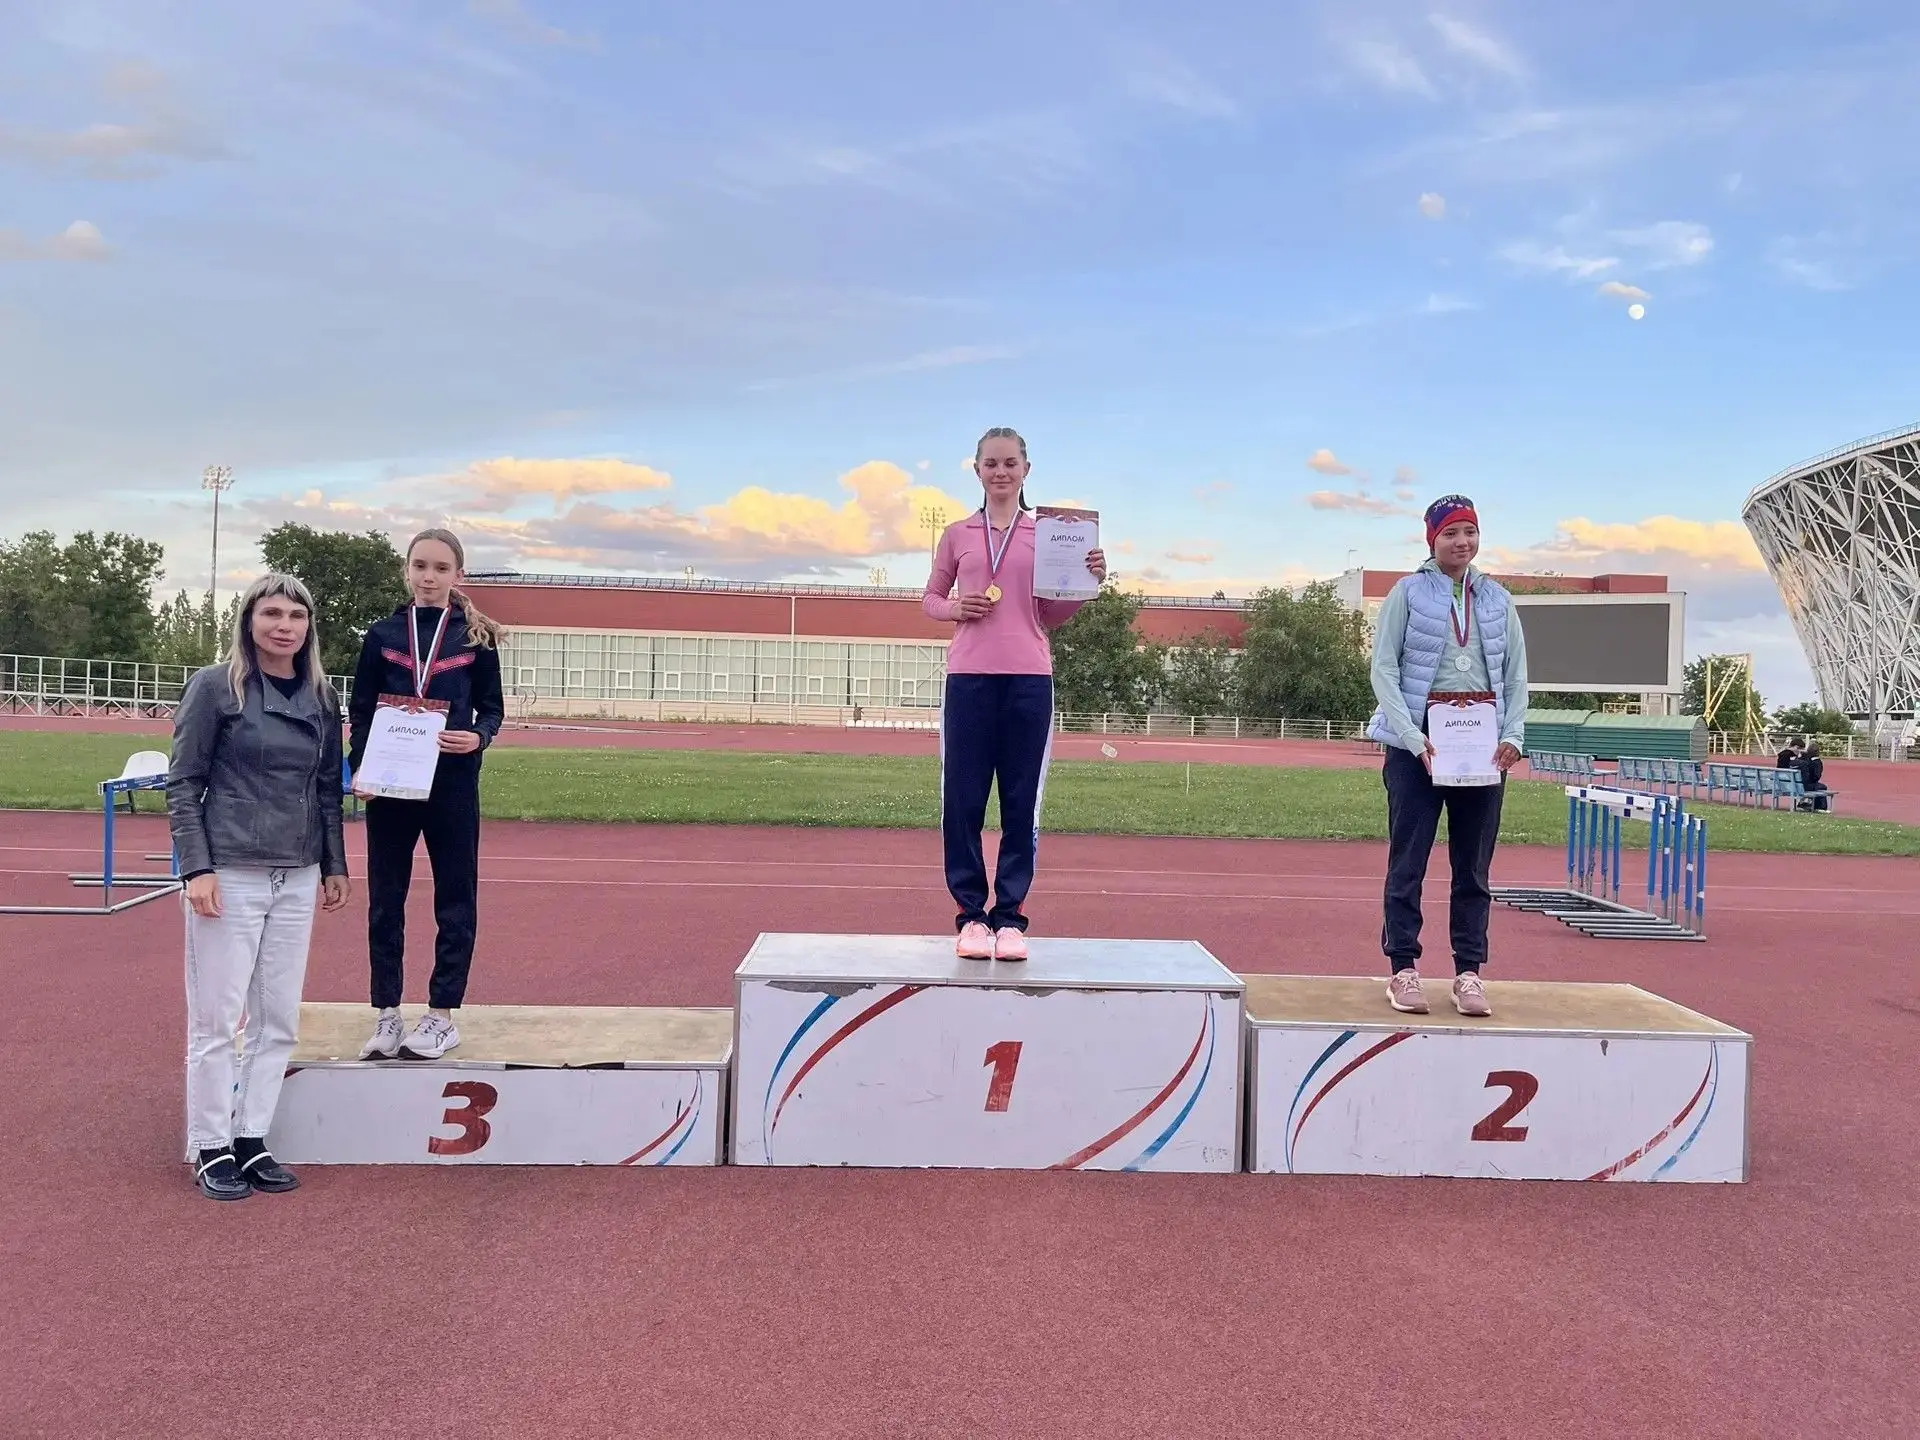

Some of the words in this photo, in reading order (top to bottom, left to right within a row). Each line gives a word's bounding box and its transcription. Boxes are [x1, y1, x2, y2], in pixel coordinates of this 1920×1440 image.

[1050, 534, 1085, 543] ДИПЛОМ
[387, 725, 427, 736] ДИПЛОМ
[1445, 720, 1482, 728] ДИПЛОМ
[983, 1041, 1024, 1112] 1
[427, 1081, 498, 1155] 3
[1470, 1070, 1540, 1142] 2
